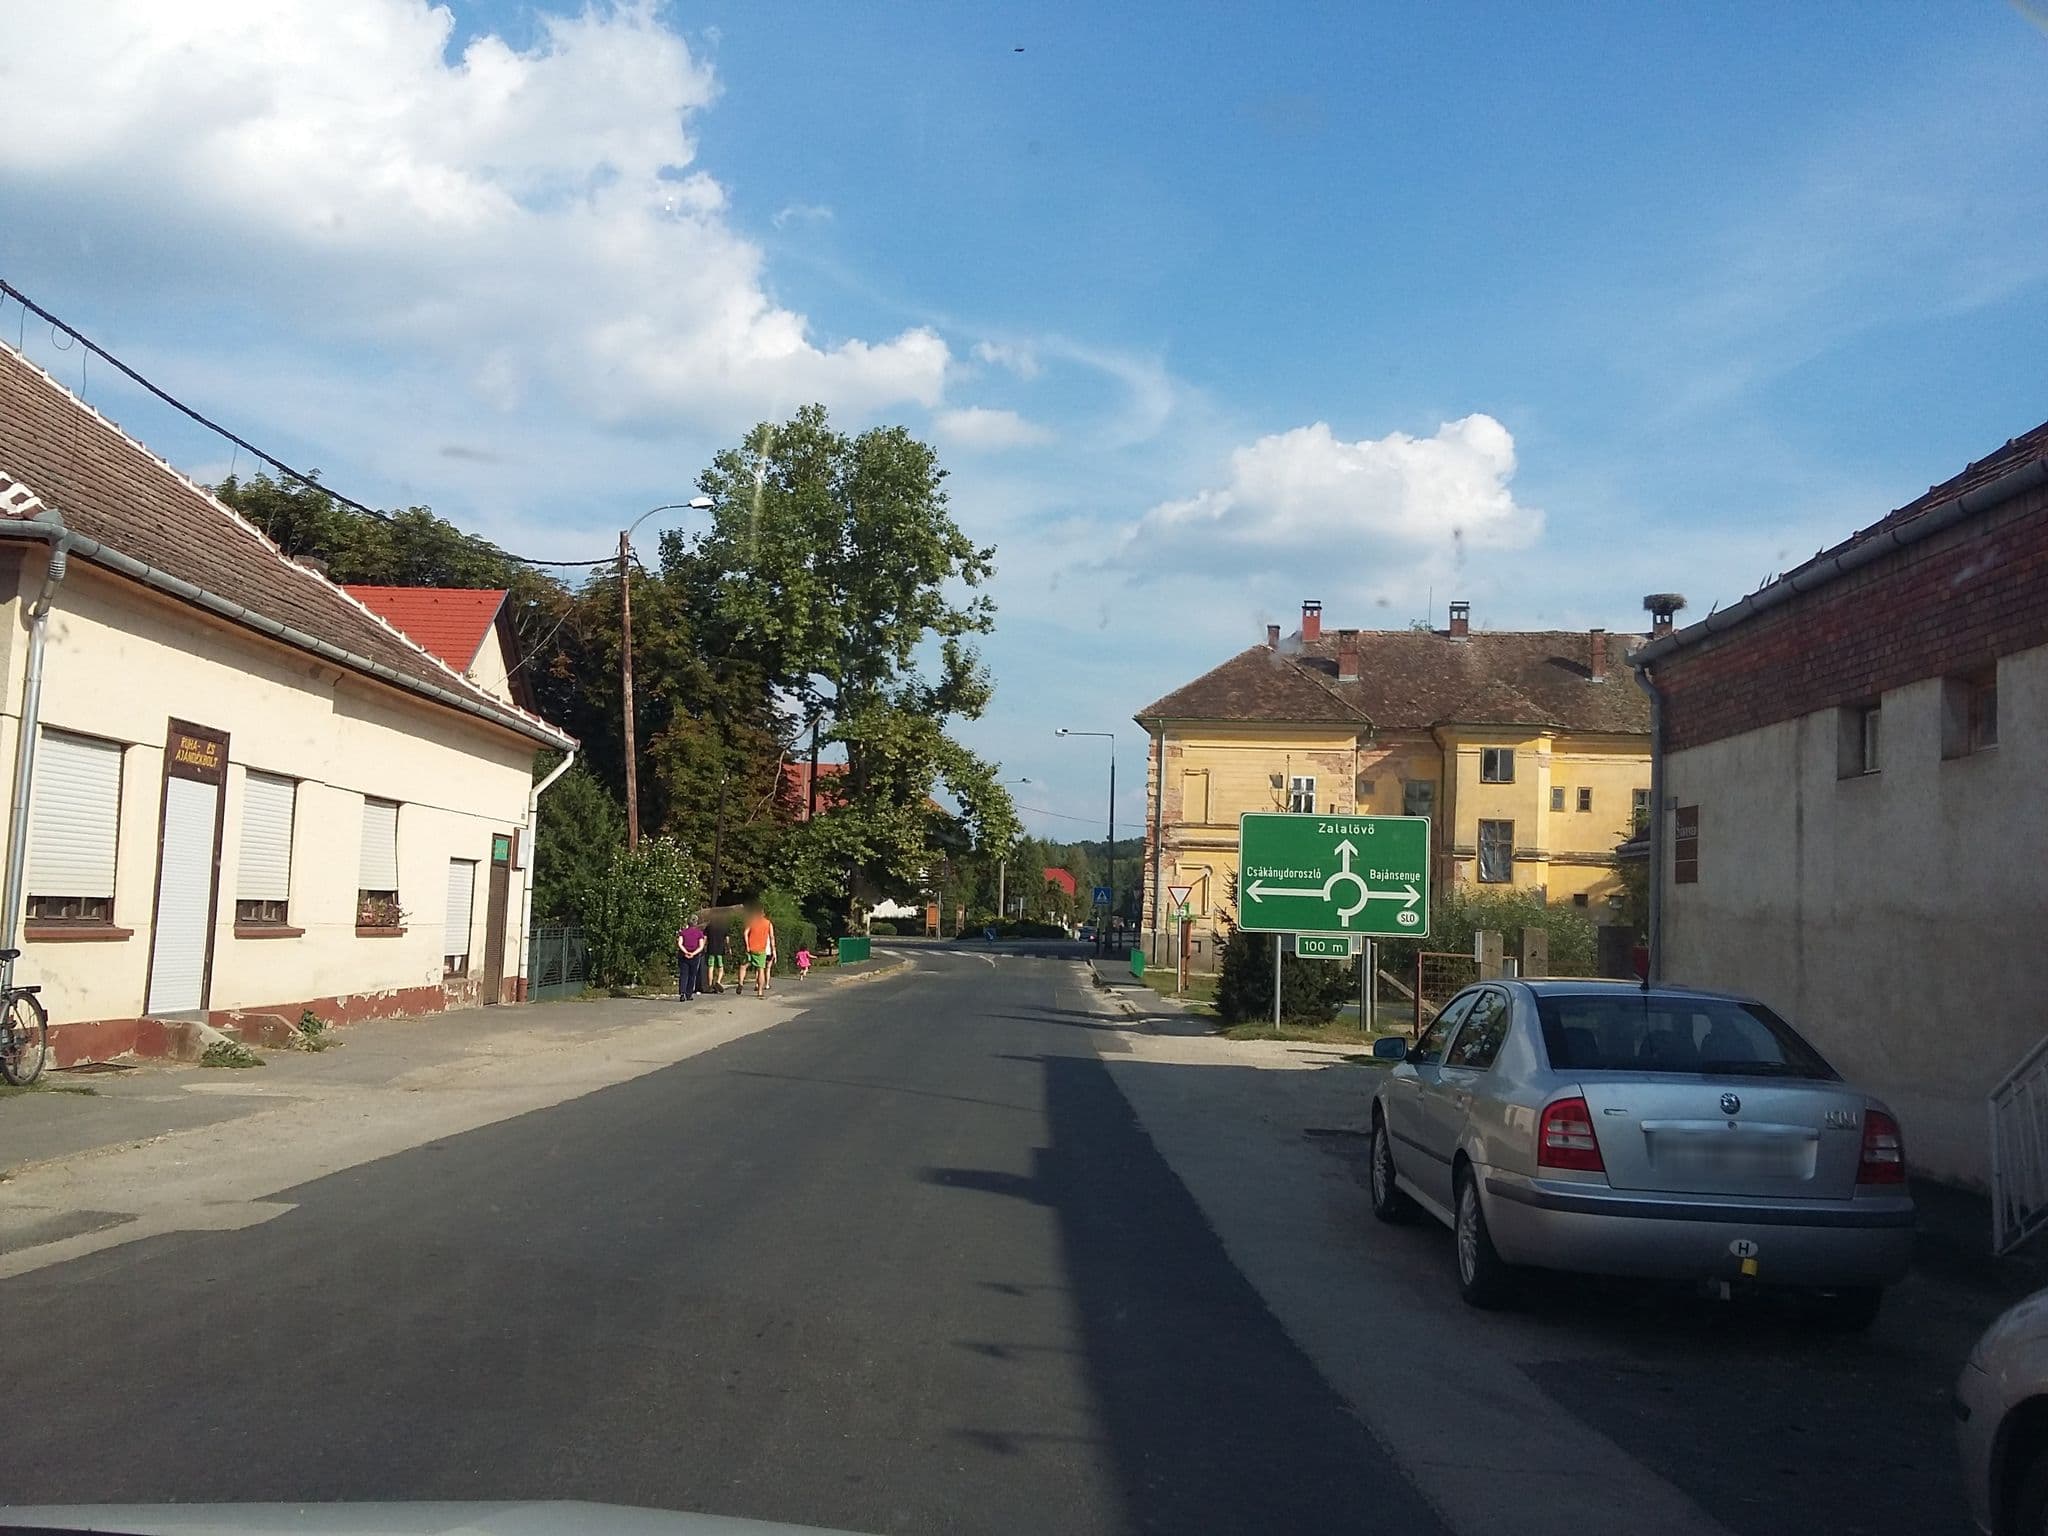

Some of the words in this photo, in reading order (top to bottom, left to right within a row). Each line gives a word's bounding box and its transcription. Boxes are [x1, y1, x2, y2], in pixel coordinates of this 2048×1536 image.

[1318, 823, 1375, 835] Zalalövő
[1246, 866, 1321, 880] Csákánydoroszló
[1369, 869, 1421, 883] Bajánsenye
[1400, 913, 1415, 923] SLO
[1304, 941, 1326, 952] 100
[1332, 943, 1343, 953] m
[1738, 1242, 1749, 1255] H
